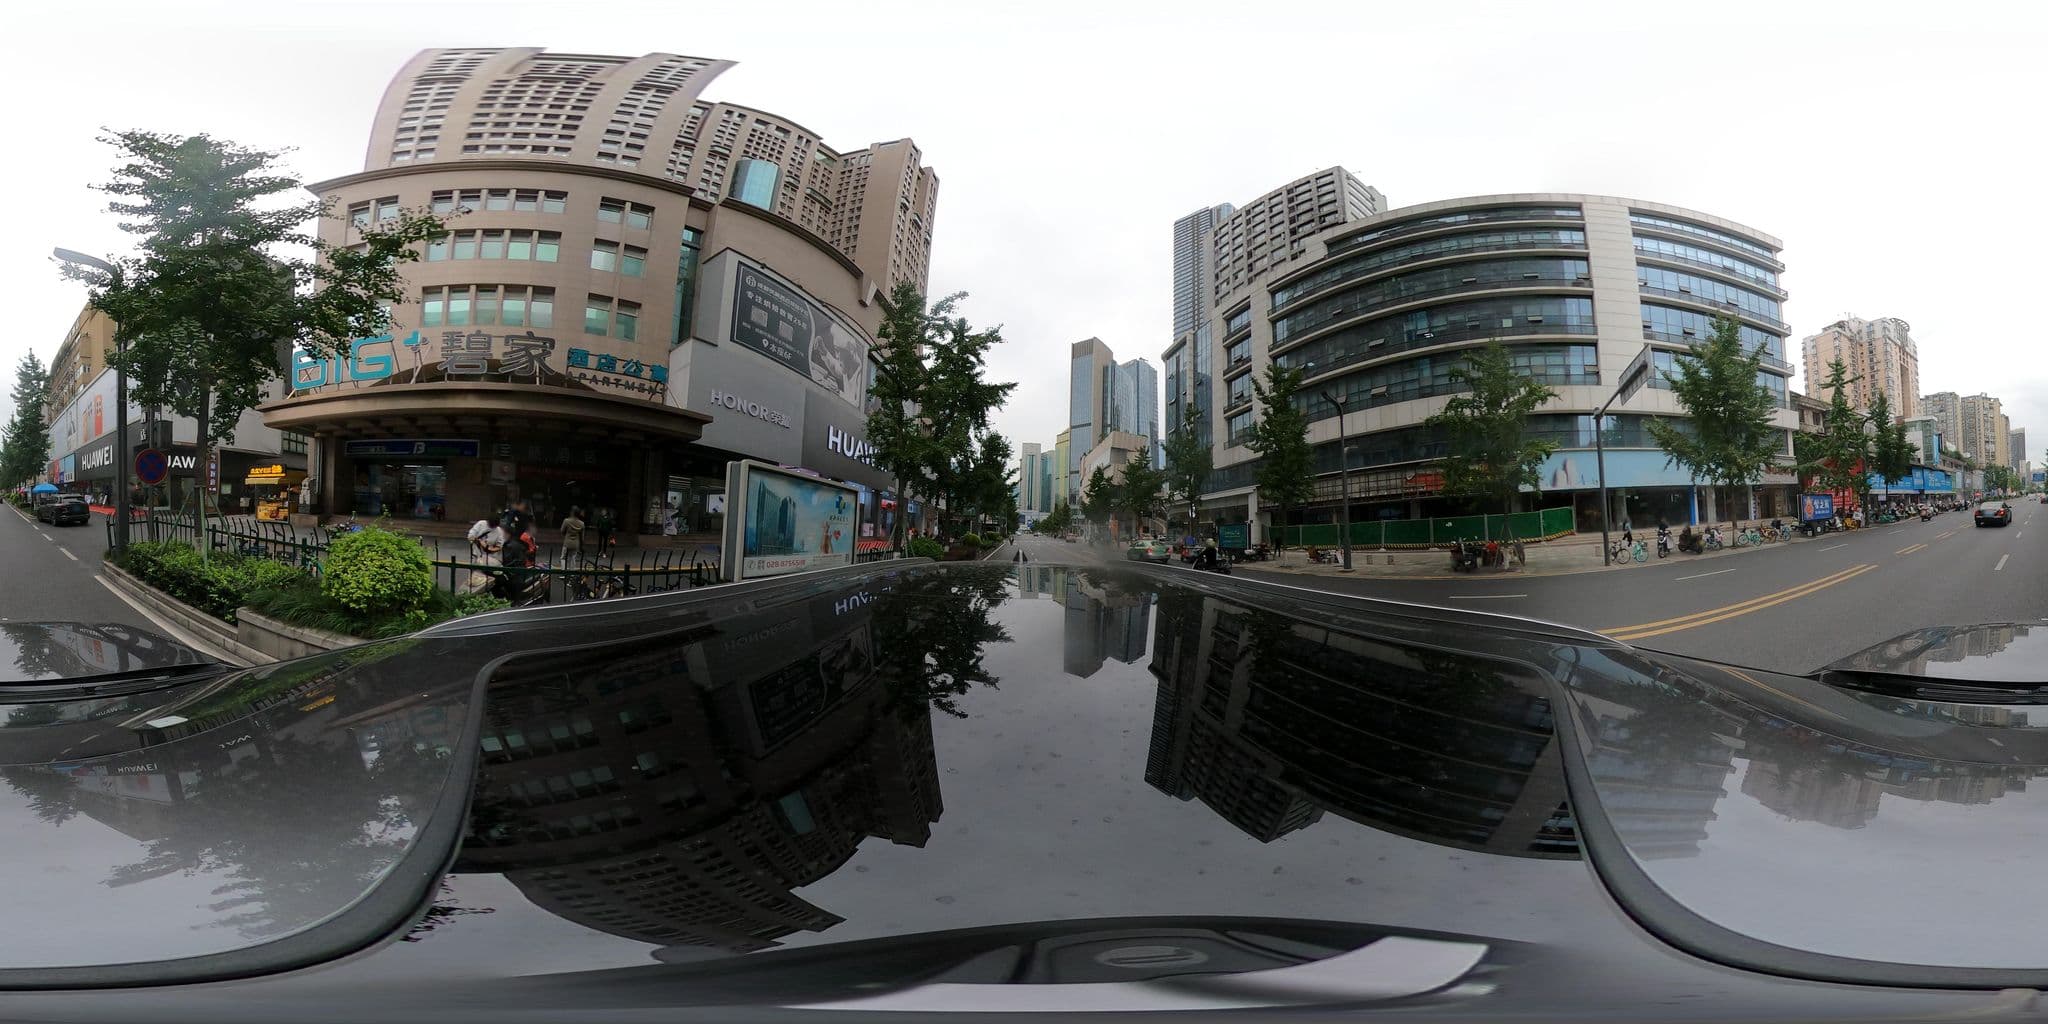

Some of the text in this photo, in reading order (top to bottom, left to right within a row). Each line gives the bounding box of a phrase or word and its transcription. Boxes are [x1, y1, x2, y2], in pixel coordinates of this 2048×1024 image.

[437, 329, 556, 376] 碧家
[567, 347, 669, 385] 酒店公寓
[710, 388, 769, 421] HONOR
[81, 445, 113, 471] HUAWEI
